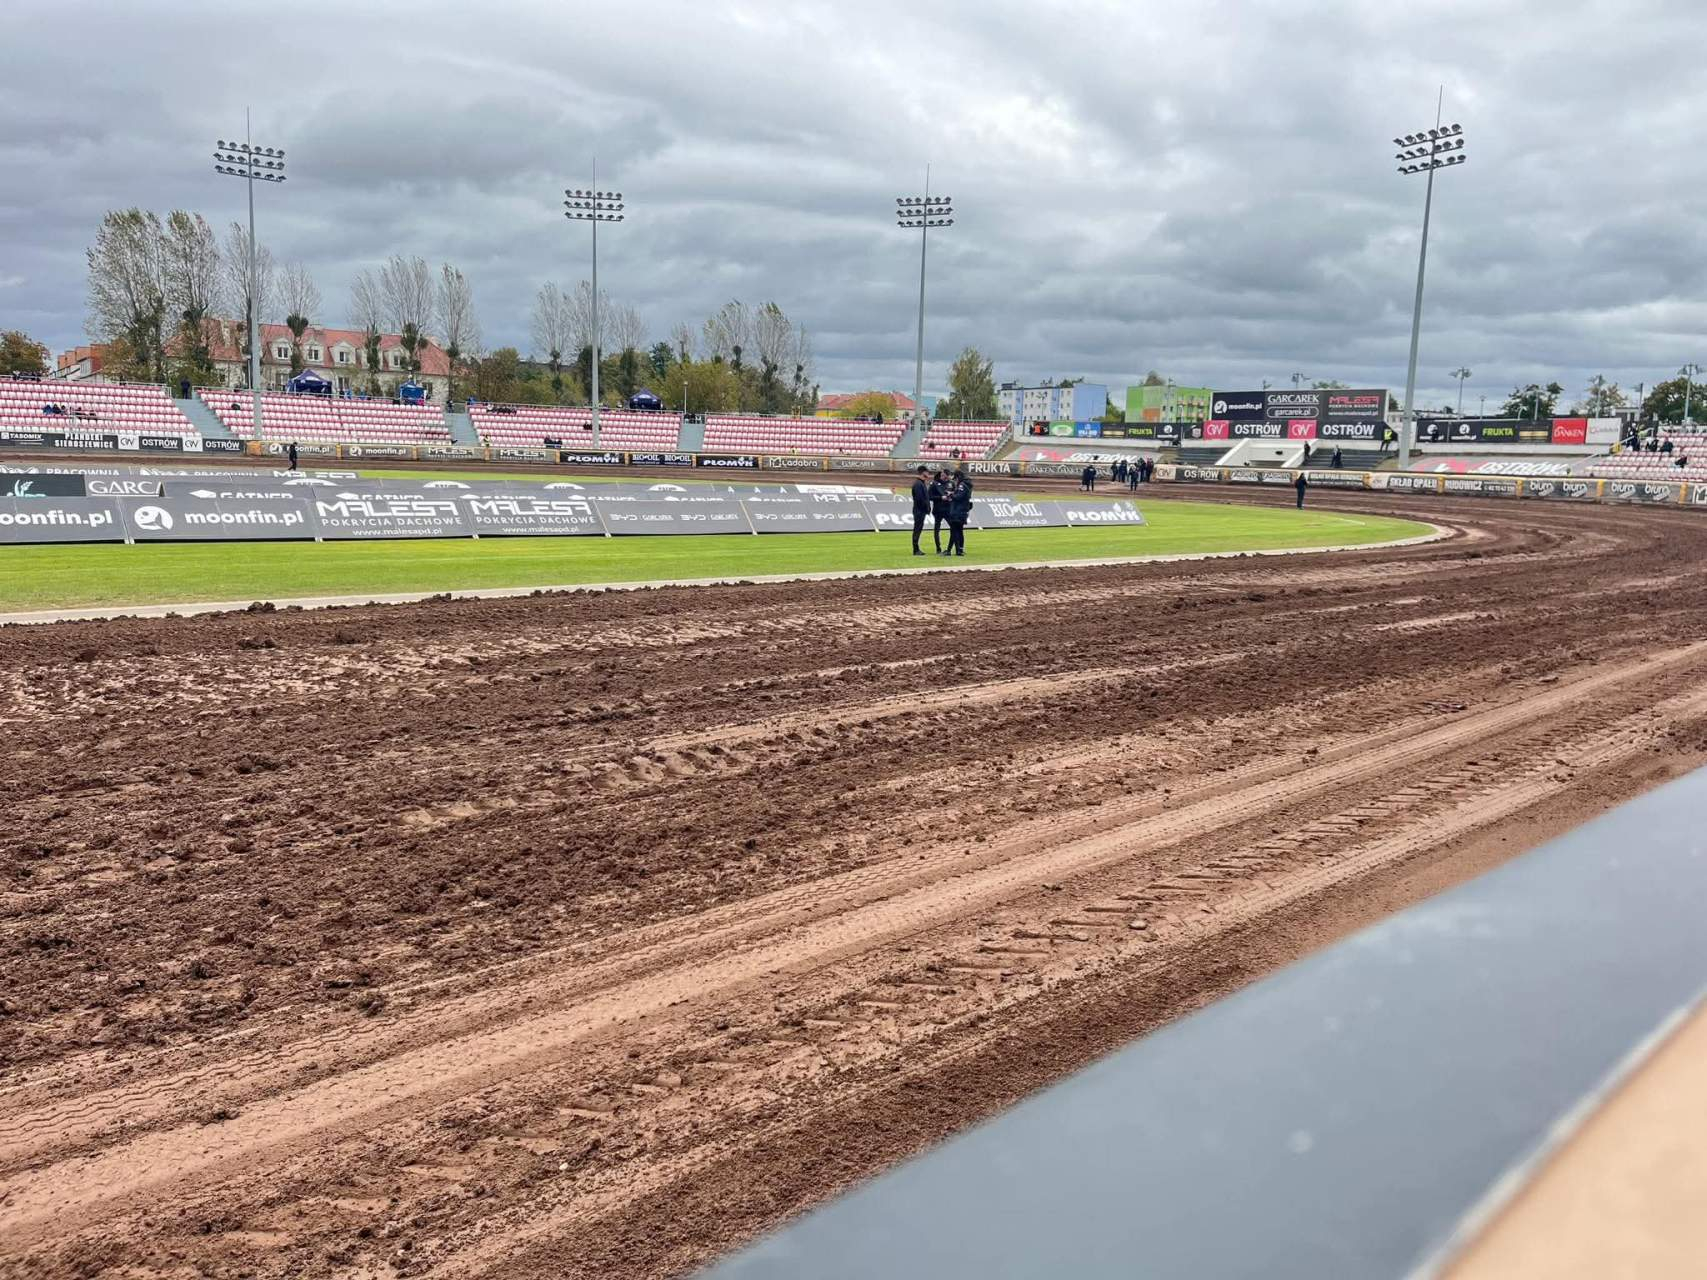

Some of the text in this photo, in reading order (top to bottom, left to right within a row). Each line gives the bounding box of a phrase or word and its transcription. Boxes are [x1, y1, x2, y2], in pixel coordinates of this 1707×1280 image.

[1267, 394, 1320, 403] GARCAREK
[1234, 422, 1281, 434] OSTRÓW
[1322, 422, 1375, 435] OSTRÓW
[1482, 428, 1514, 436] FRUKTA
[142, 438, 178, 447] OSTRÓW
[205, 440, 240, 449] OSTRÓW
[365, 446, 407, 455] moonfin.pl
[968, 463, 1012, 473] FRUKTA
[315, 500, 460, 517] MALESA
[469, 500, 592, 516] MALESA
[184, 510, 305, 527] moonfin.pl
[322, 516, 463, 527] POKRYCIA DACHOWE
[476, 516, 596, 525] POKRYCIA DACHOWE
